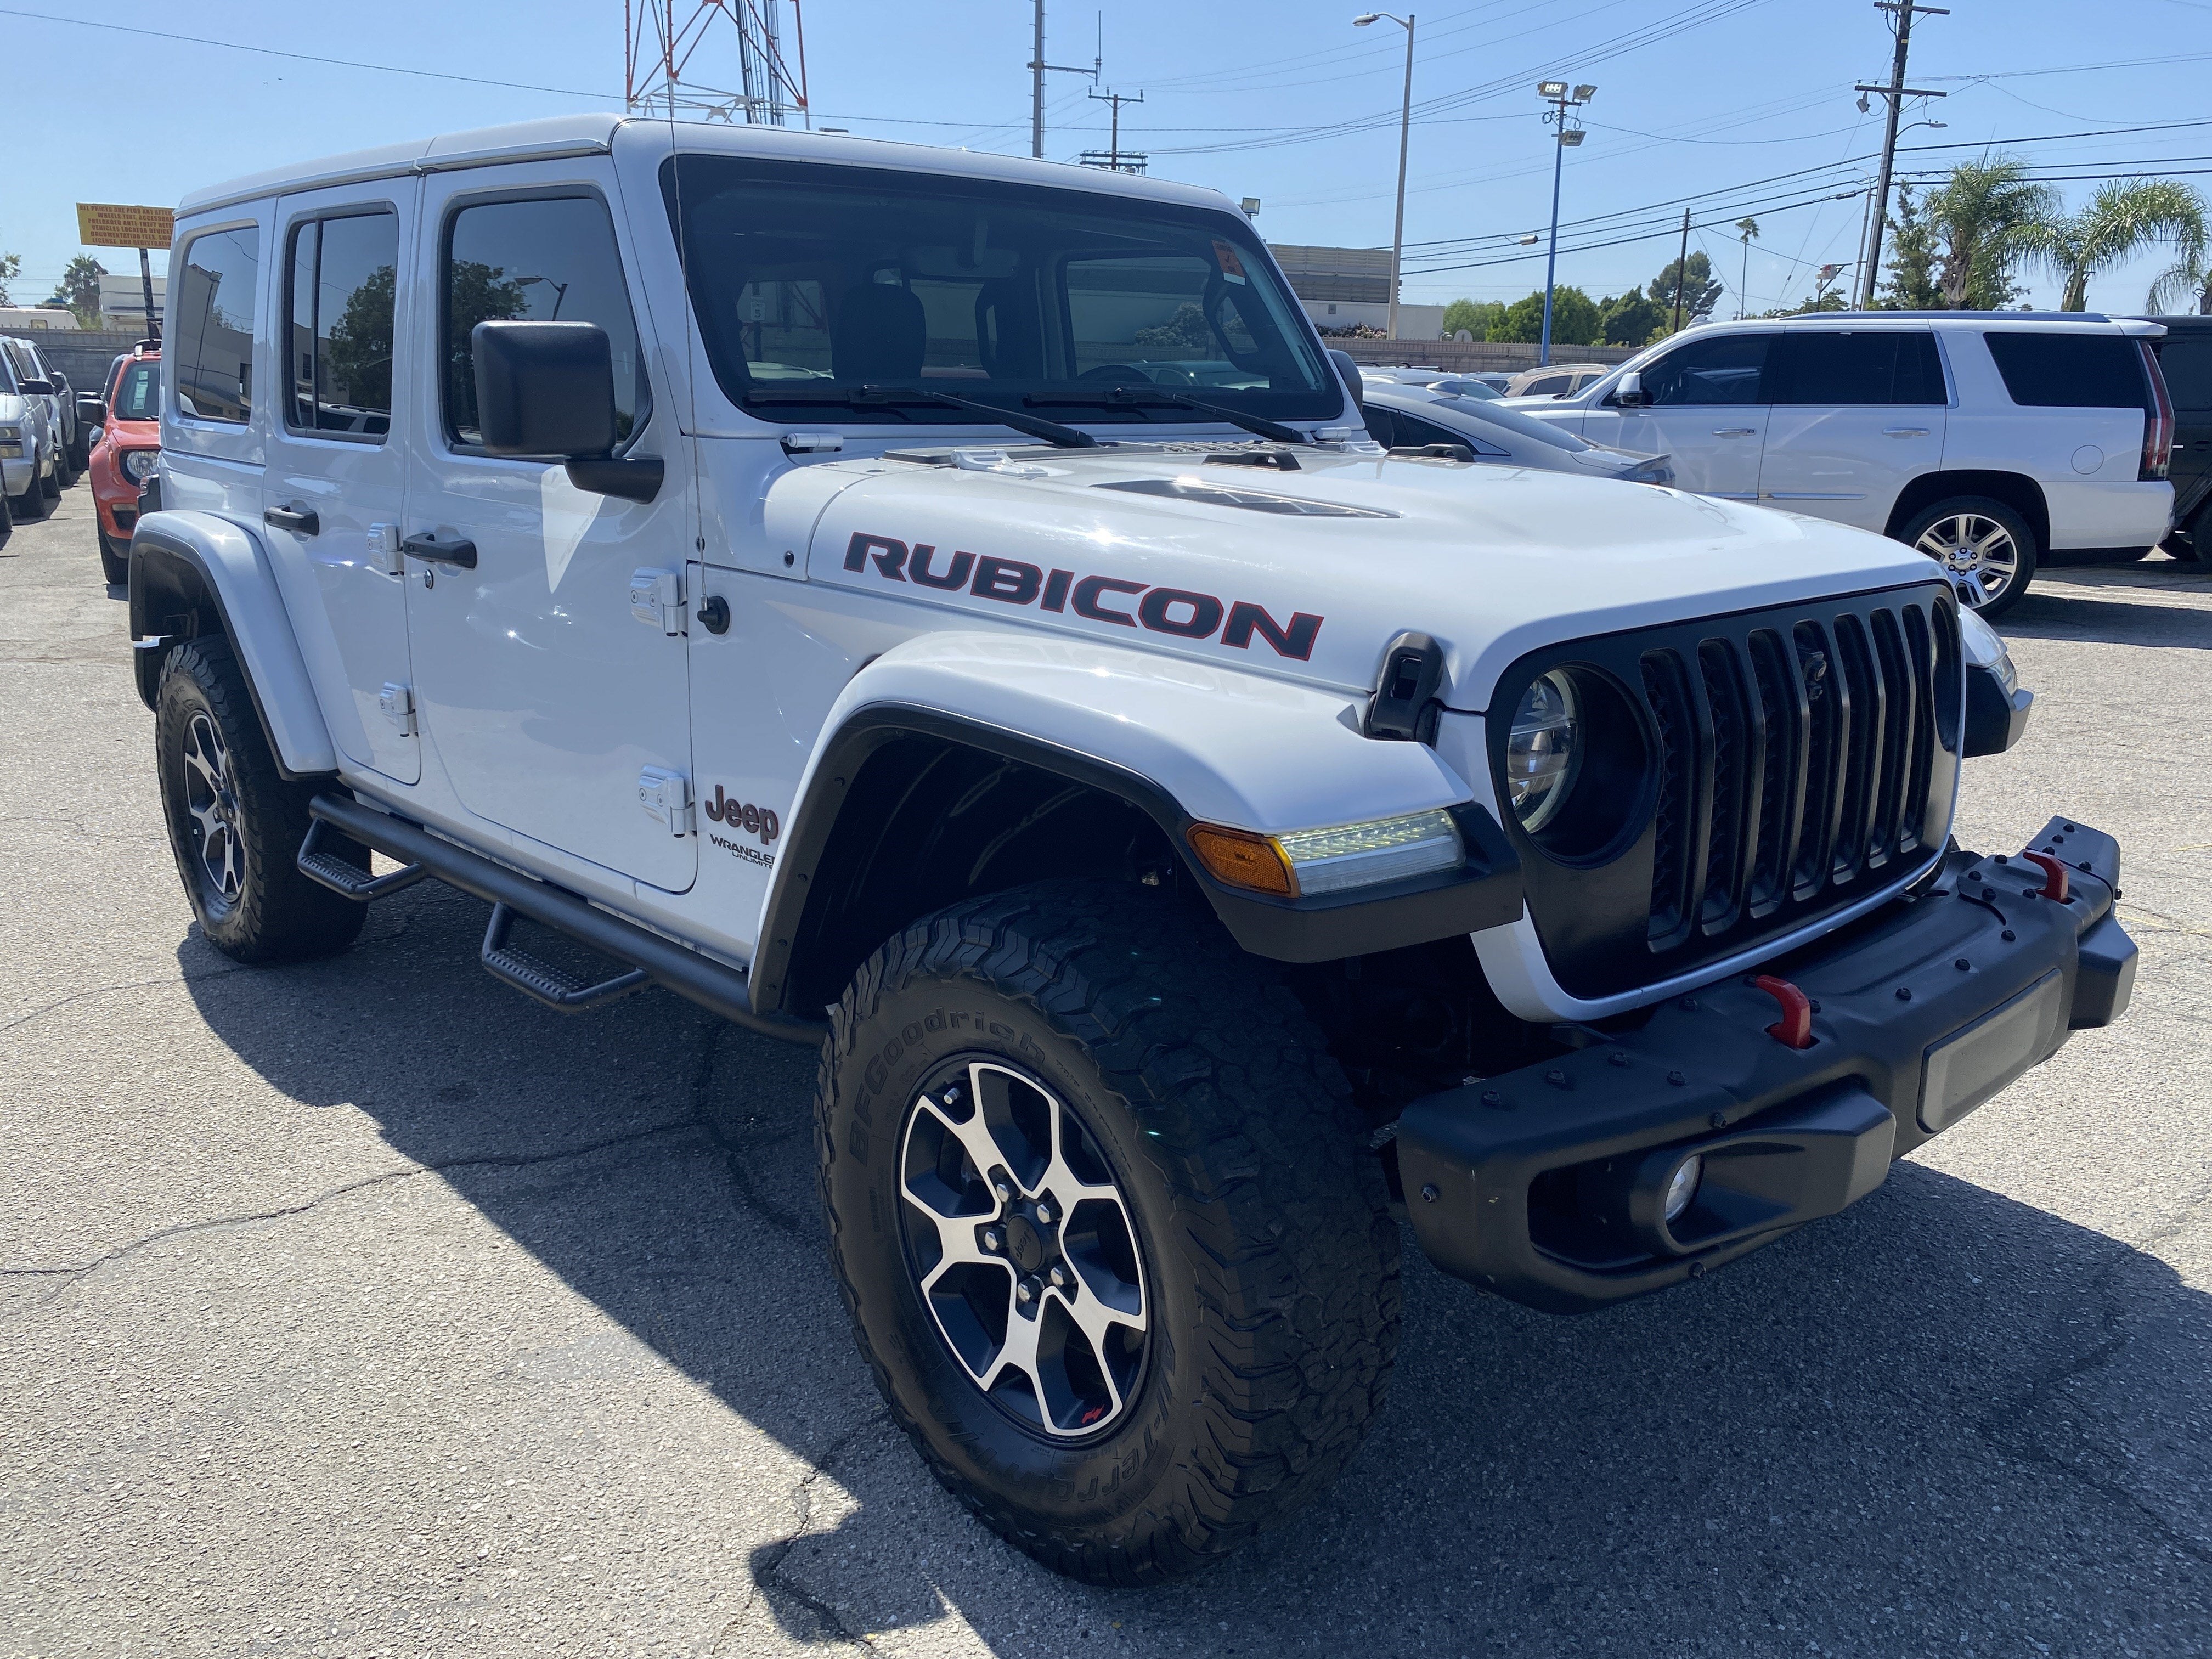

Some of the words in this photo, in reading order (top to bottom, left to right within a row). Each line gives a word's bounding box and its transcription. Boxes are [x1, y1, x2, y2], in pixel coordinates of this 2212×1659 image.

[754, 309, 761, 318] 5
[843, 531, 1324, 661] RUBICON
[704, 785, 779, 845] Jeep
[849, 1007, 1046, 1166] BFGoodrich
